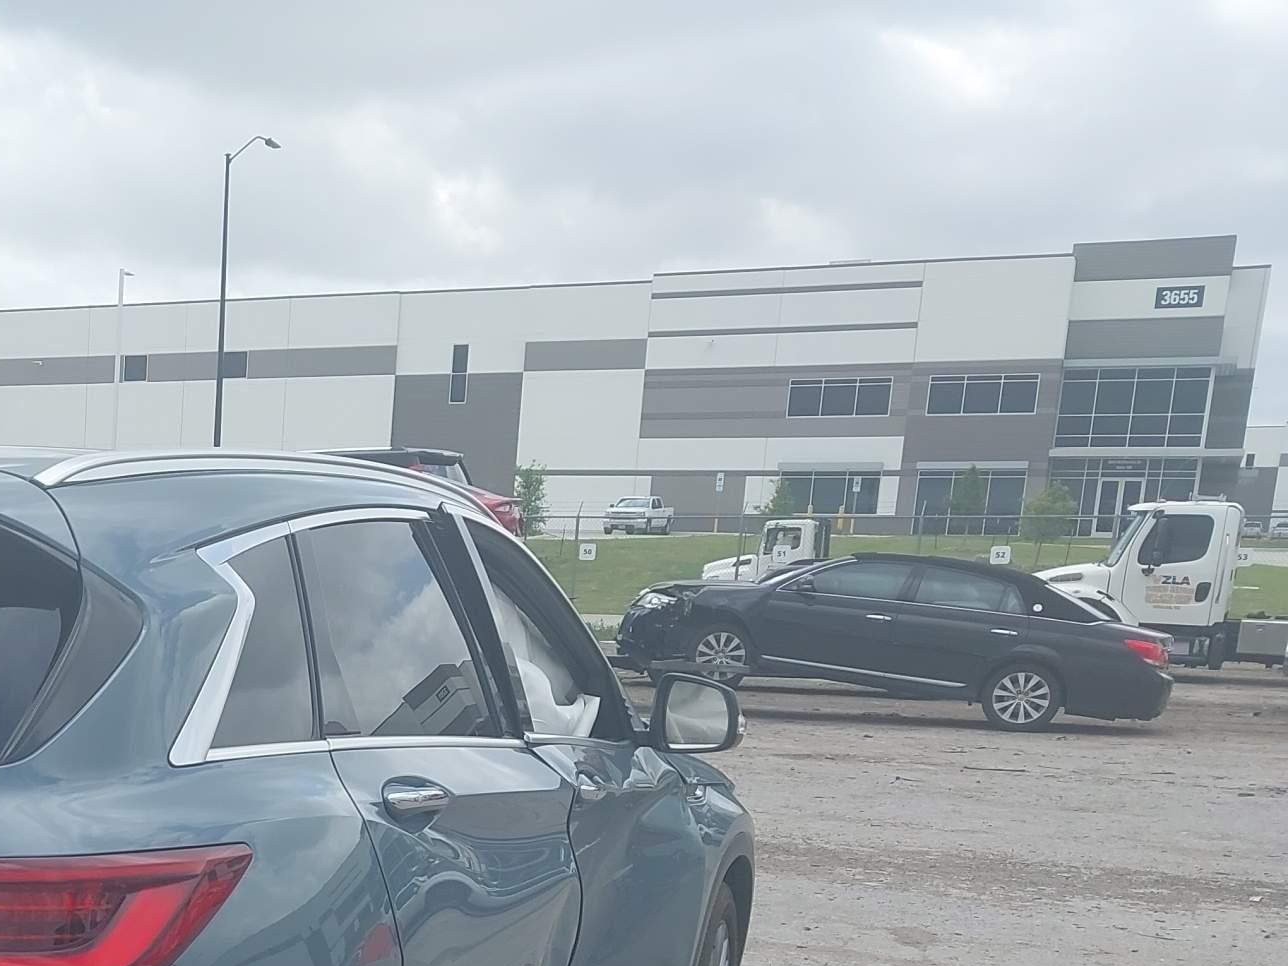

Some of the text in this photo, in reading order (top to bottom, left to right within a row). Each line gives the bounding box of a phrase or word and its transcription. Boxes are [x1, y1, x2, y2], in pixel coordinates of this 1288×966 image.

[1160, 289, 1199, 305] 3655
[777, 550, 787, 558] 51
[995, 551, 1006, 559] 52
[1237, 553, 1249, 561] 53
[1161, 575, 1191, 585] ZLA
